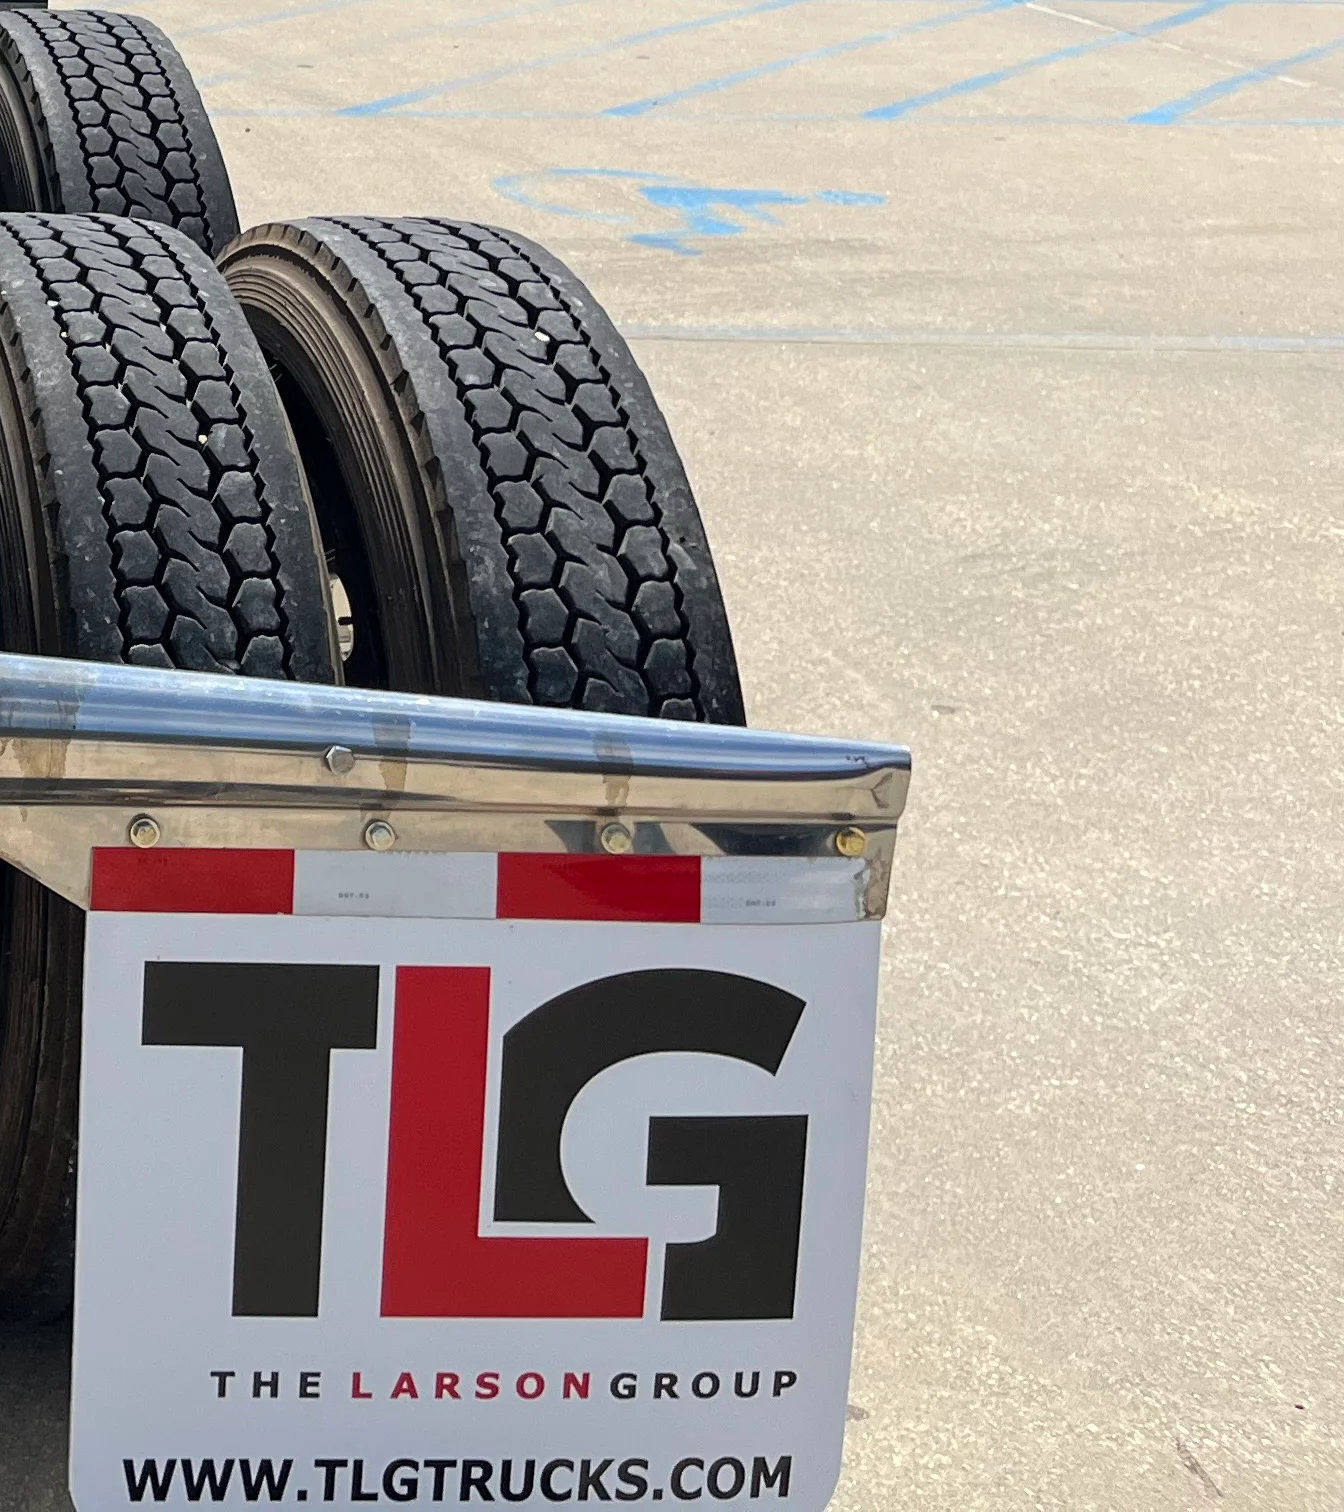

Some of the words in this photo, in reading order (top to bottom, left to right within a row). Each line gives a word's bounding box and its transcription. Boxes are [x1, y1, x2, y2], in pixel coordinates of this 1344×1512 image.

[141, 960, 810, 1323] TLG
[210, 1370, 324, 1400] THE
[122, 1455, 794, 1503] WWW.TLGTRUCKS.COM
